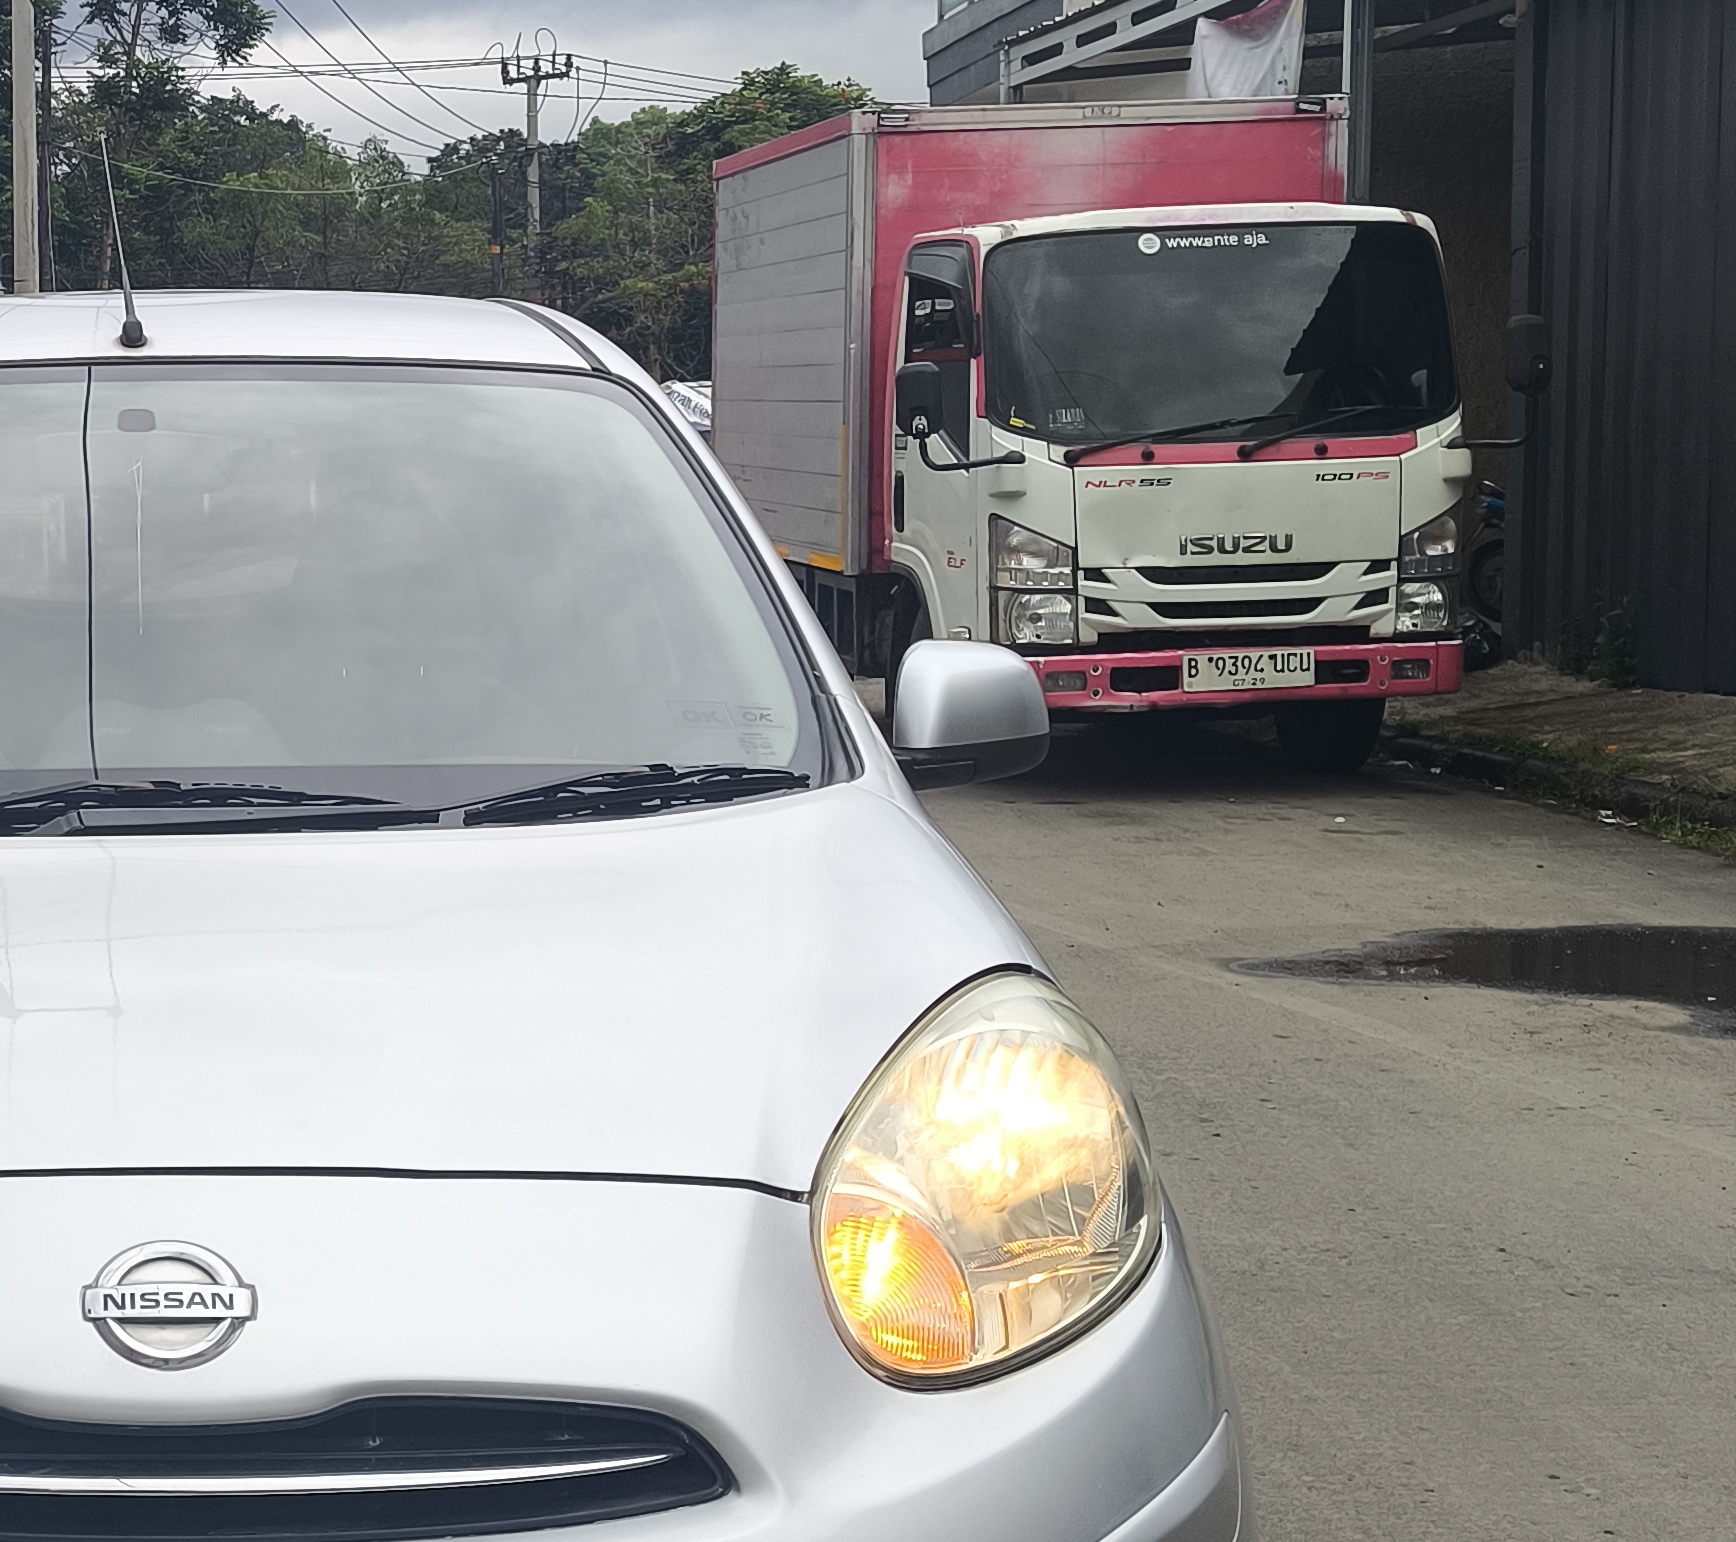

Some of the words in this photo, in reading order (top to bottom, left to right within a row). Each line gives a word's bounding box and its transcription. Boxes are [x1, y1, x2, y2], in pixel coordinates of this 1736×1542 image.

[1084, 479, 1136, 489] NLR
[1315, 472, 1354, 482] 100
[1356, 471, 1391, 481] PS
[1179, 531, 1294, 556] ISUZU
[1187, 657, 1200, 679] B
[1214, 654, 1265, 677] 9394
[1273, 651, 1311, 673] UCU
[742, 711, 774, 723] OK
[102, 1291, 235, 1312] NISSAN
